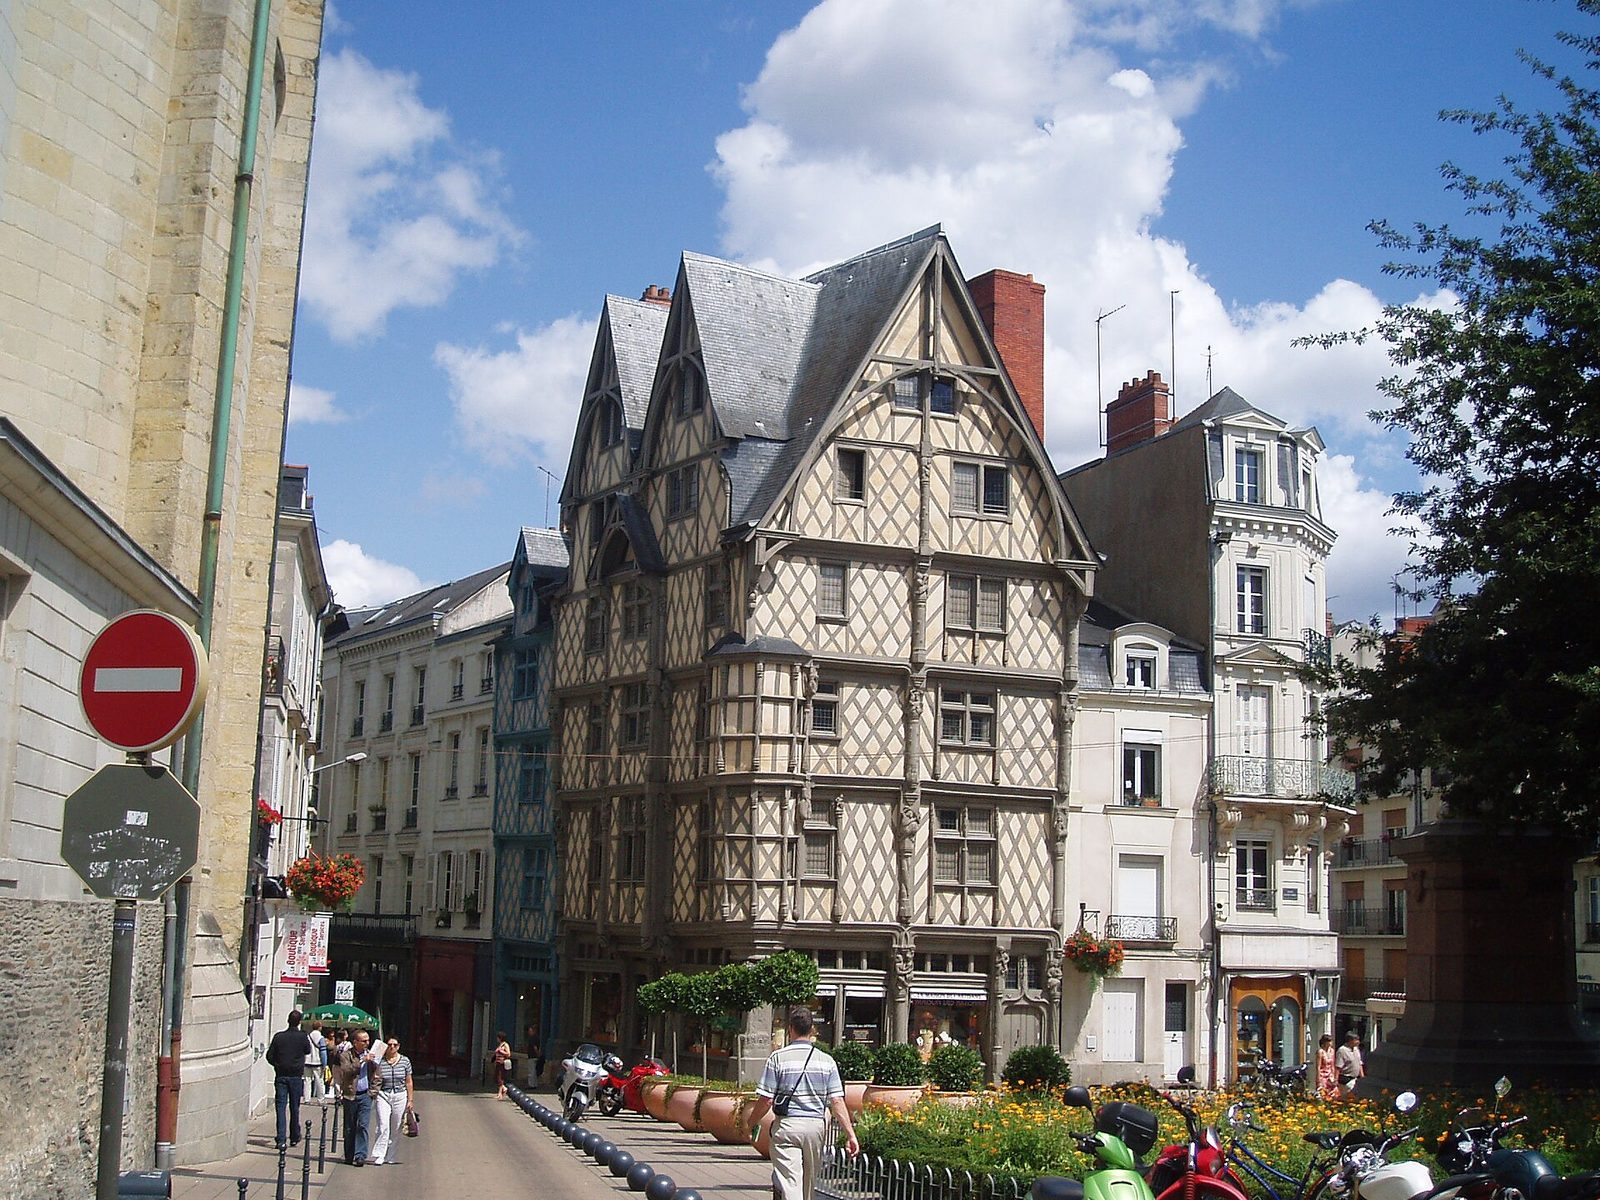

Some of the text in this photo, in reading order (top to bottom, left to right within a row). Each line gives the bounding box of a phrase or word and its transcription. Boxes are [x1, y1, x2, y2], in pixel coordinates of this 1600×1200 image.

[286, 930, 298, 966] Boutique
[299, 921, 307, 946] Services
[309, 928, 318, 957] Boutique
